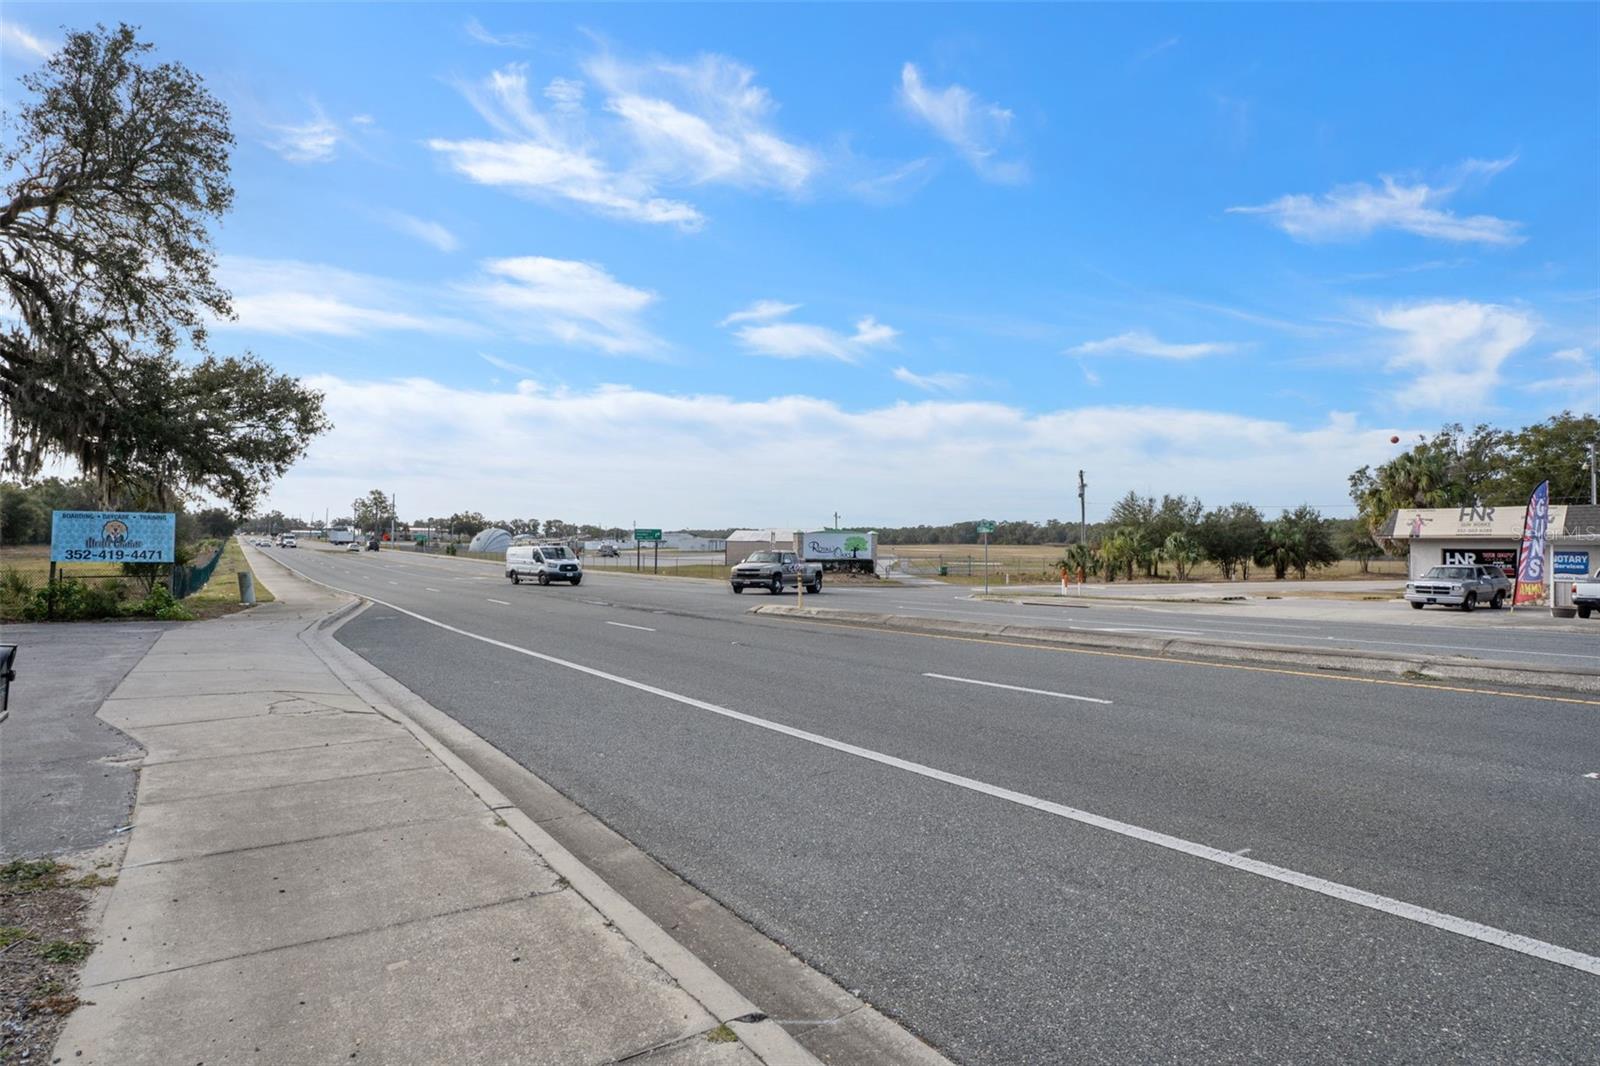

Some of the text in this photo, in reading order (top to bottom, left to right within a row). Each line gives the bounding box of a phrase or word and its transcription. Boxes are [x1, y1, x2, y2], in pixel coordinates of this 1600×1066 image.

[1459, 505, 1496, 521] HNR
[1528, 499, 1544, 577] GUNS
[65, 549, 162, 560] 352-419-4471
[1445, 552, 1477, 565] HNR
